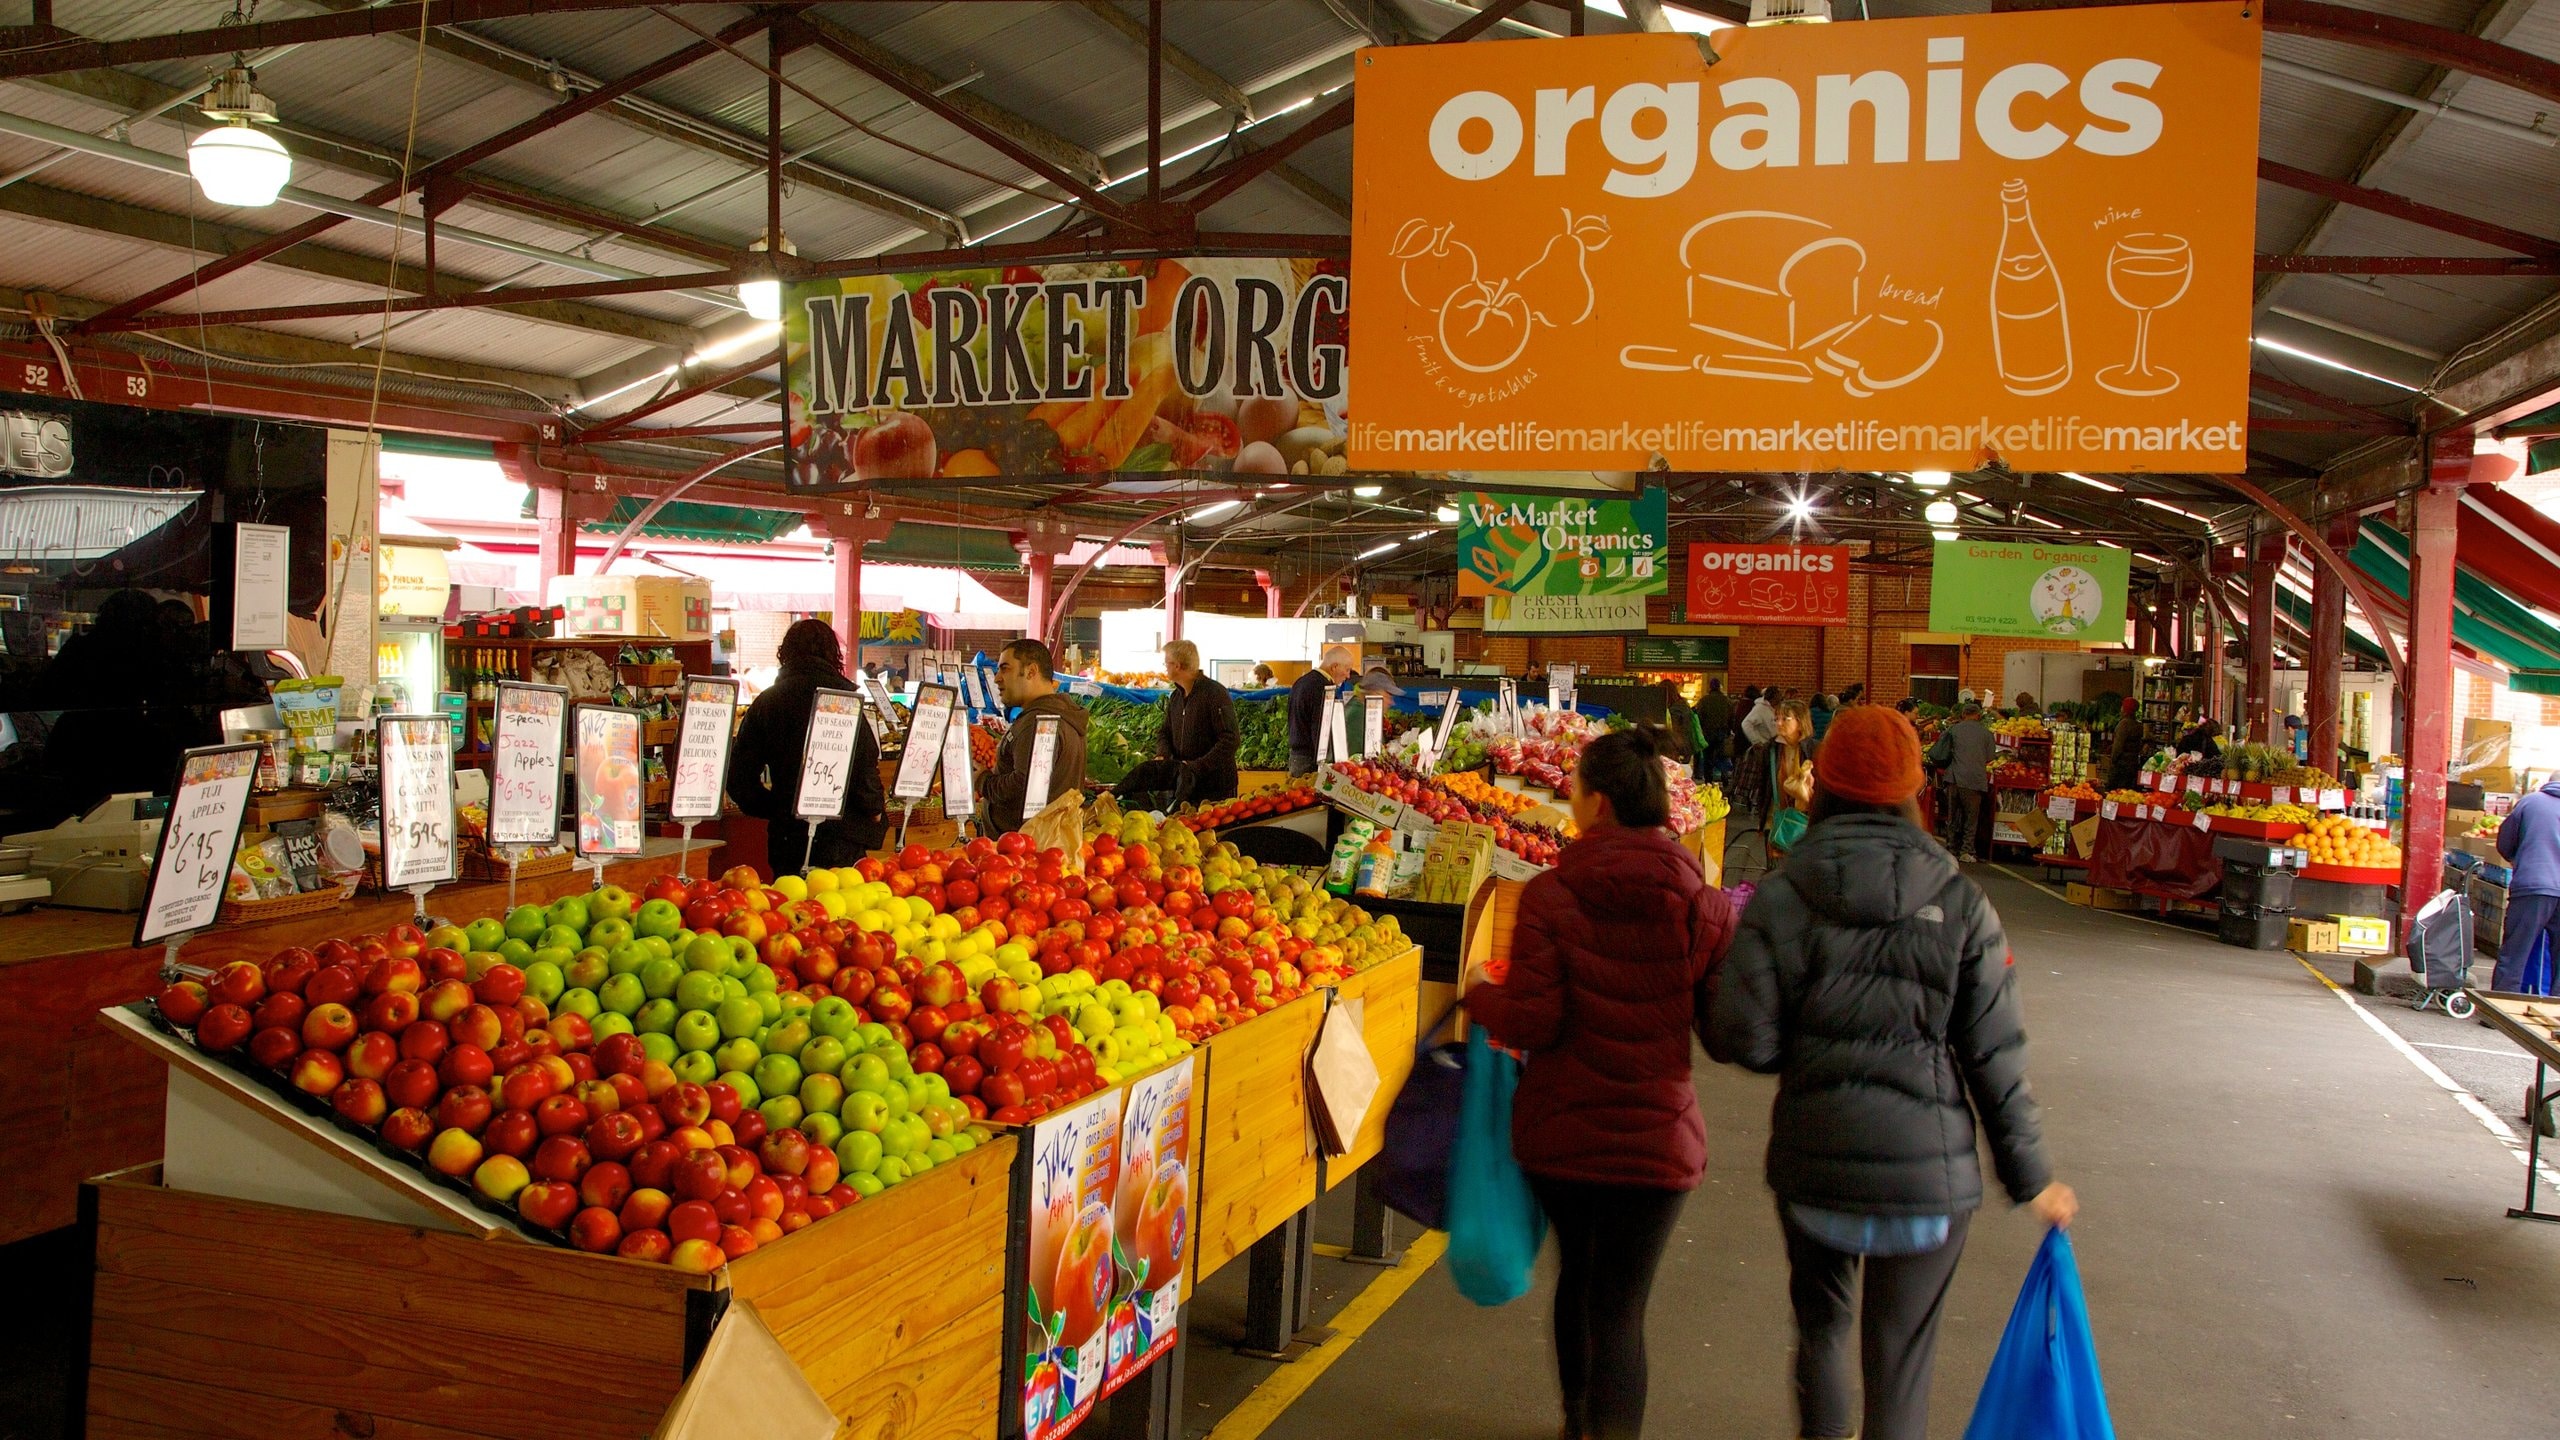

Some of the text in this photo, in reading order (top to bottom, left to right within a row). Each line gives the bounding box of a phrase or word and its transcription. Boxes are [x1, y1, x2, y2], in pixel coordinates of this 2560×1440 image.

[1428, 36, 2164, 198] organics
[2093, 206, 2143, 230] wine
[1878, 274, 1945, 309] bread
[805, 273, 1348, 416] MARKET ORG
[25, 365, 48, 386] 52
[1407, 335, 1442, 376] fruit
[1447, 367, 1539, 409] vegetables
[127, 377, 146, 396] 53
[543, 425, 555, 440] 54
[594, 475, 607, 491] 55
[843, 503, 853, 516] 56
[1542, 527, 1653, 557] Organics
[1703, 550, 1834, 575] organics
[1969, 546, 2098, 563] Garden Organics
[1523, 606, 1640, 620] GENERATION
[506, 714, 551, 726] Special
[688, 706, 727, 718] NEW SEASON
[927, 708, 947, 718] SEASON
[692, 720, 716, 731] APPLES
[816, 716, 853, 727] NEW SEASON
[500, 734, 538, 749] Jazz
[688, 734, 715, 744] GOLDEN
[821, 730, 843, 739] APPLES
[683, 748, 717, 758] DELICIOUS
[812, 741, 848, 752] ROYAL GALA
[413, 752, 444, 763] SEASON
[514, 751, 555, 771] Apples
[201, 785, 222, 800] FUJI
[190, 802, 225, 820] APPLES
[198, 864, 219, 890] kg
[1086, 1112, 1099, 1128] JAZZ
[1126, 1085, 1157, 1166] JAZZ
[1037, 1121, 1079, 1209] JAZZ
[1129, 1144, 1151, 1182] Apple
[1048, 1184, 1072, 1228] Apple
[1106, 1332, 1174, 1393] www.jazzapple.com.au
